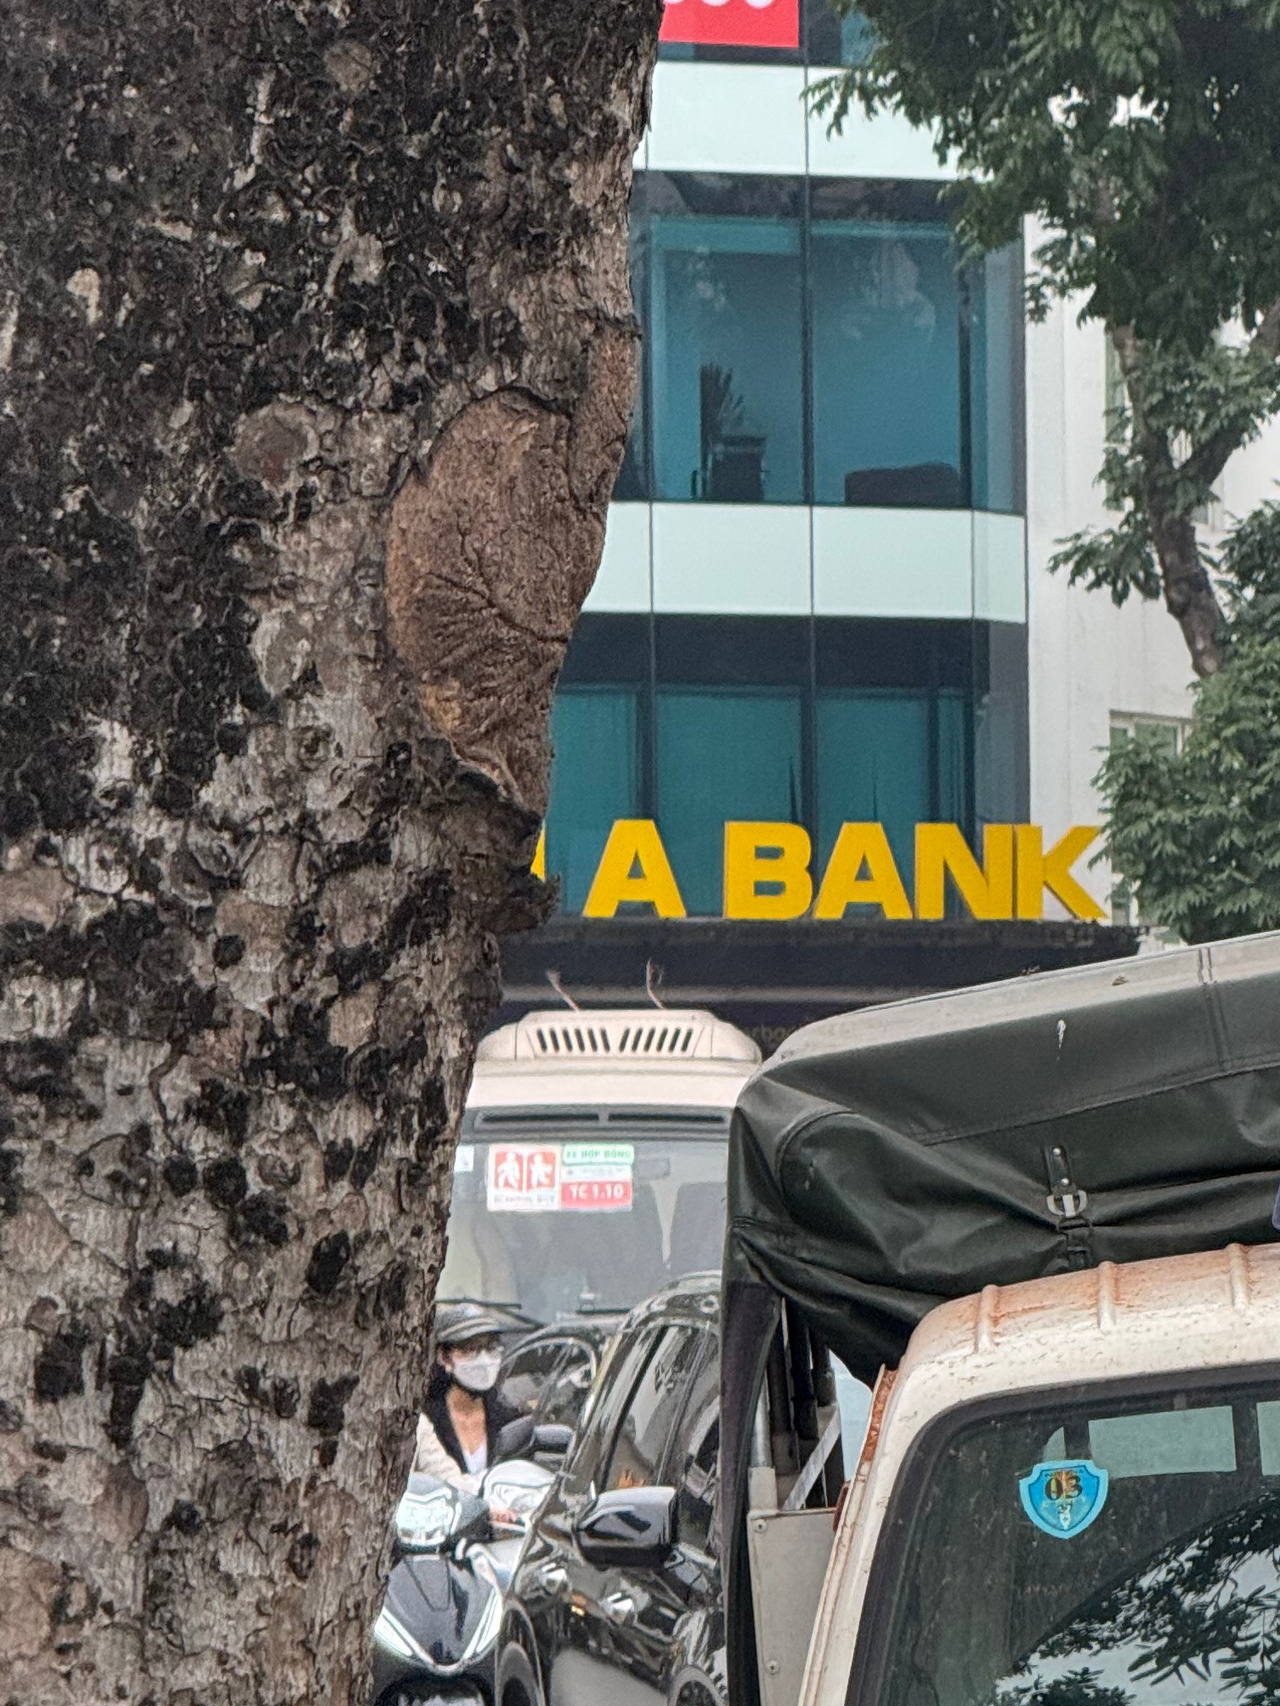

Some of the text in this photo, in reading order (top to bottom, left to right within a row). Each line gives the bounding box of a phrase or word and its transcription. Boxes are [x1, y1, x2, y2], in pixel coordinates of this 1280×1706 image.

[582, 818, 688, 919] A
[723, 820, 1109, 921] BANK
[1045, 1475, 1083, 1501] 03
